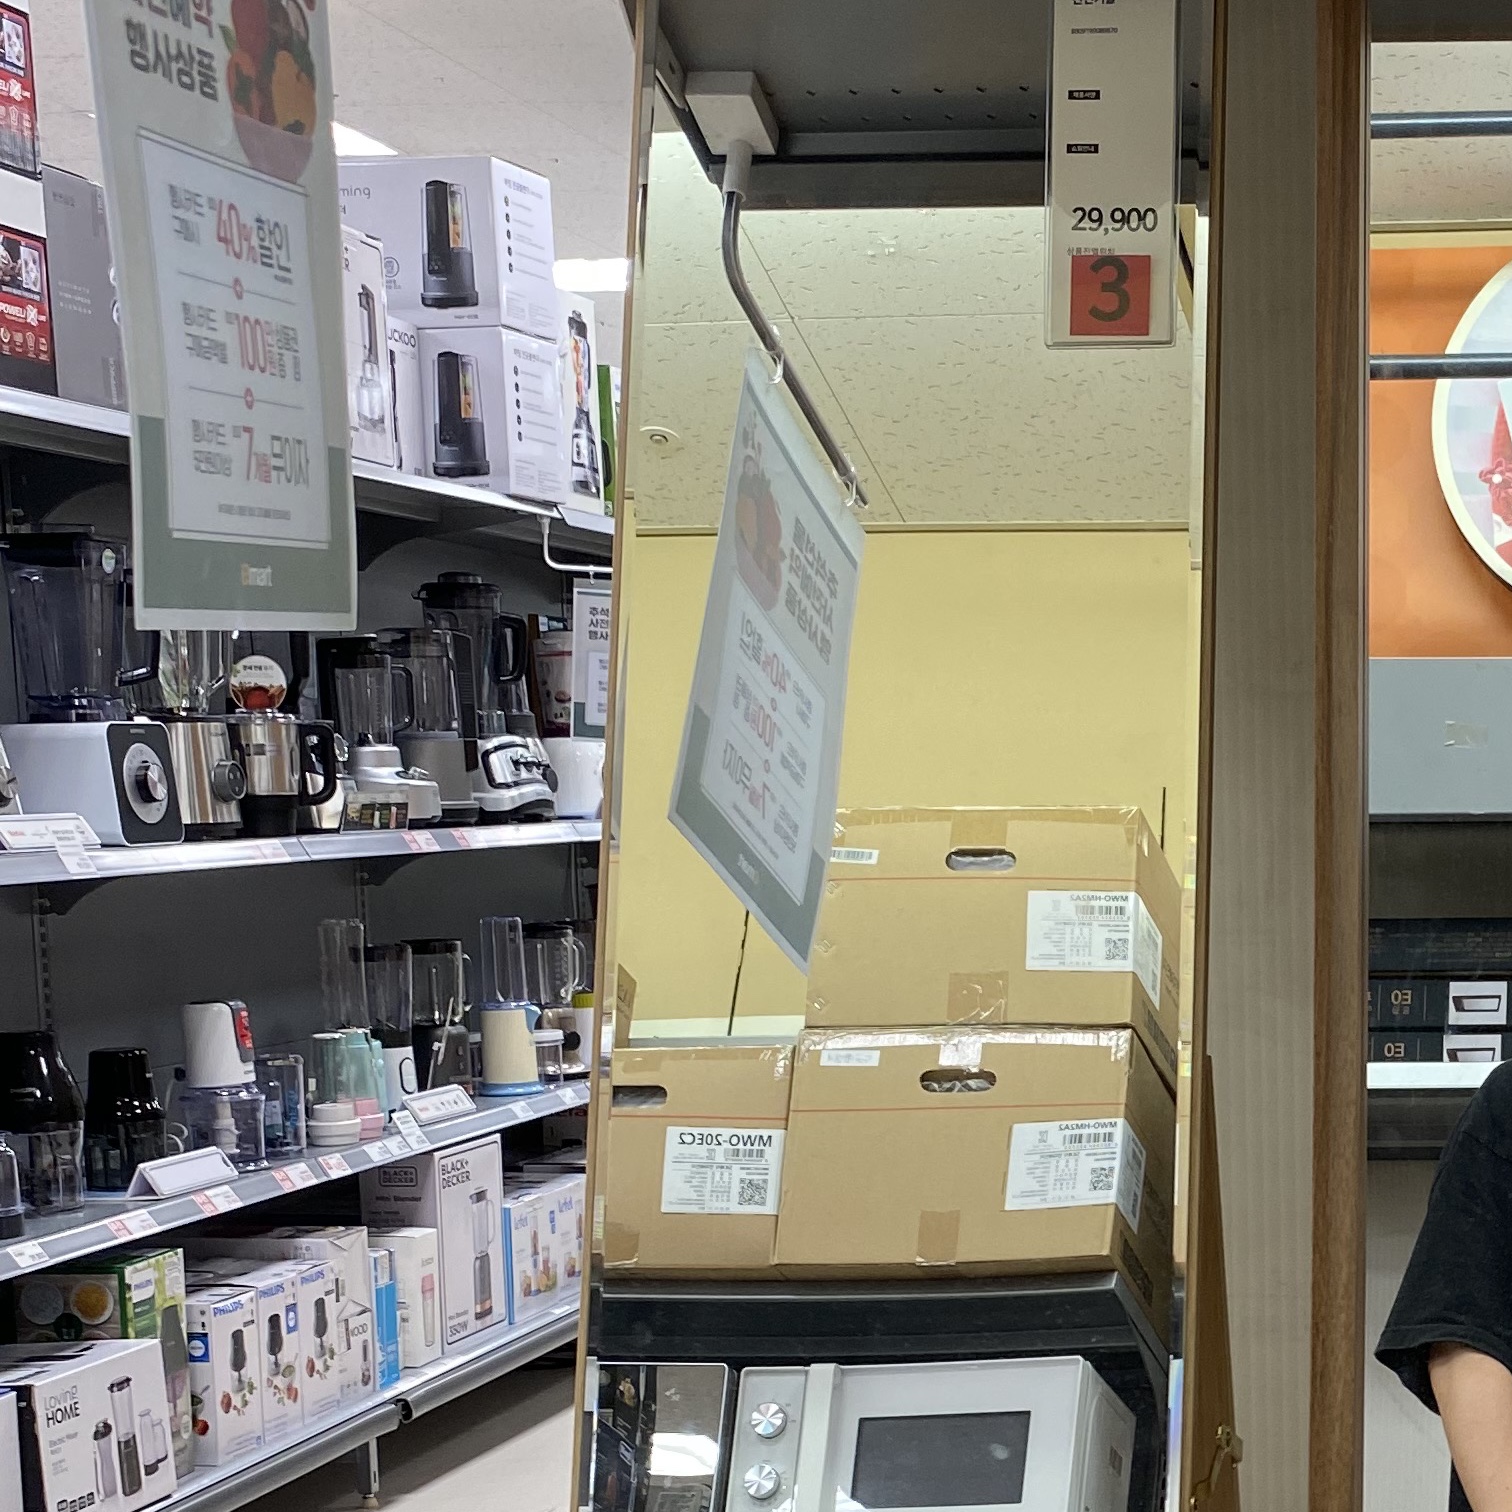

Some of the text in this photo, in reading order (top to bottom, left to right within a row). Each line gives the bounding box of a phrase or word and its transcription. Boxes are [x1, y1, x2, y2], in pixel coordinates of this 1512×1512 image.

[125, 18, 219, 102] 행사상품
[1071, 206, 1158, 236] 29,900
[256, 215, 293, 274] 할인
[1088, 256, 1131, 322] 3
[589, 606, 609, 618] 추석
[588, 617, 609, 630] 사전
[588, 630, 609, 641] 행사
[441, 1159, 470, 1176] BLACK+
[441, 1171, 472, 1190] DECKER
[300, 1269, 325, 1286] PHILIPS
[258, 1283, 285, 1300] PHILIPS
[212, 1299, 245, 1318] PHILIPS
[44, 1385, 78, 1410] Loving
[45, 1401, 80, 1428] HOME
